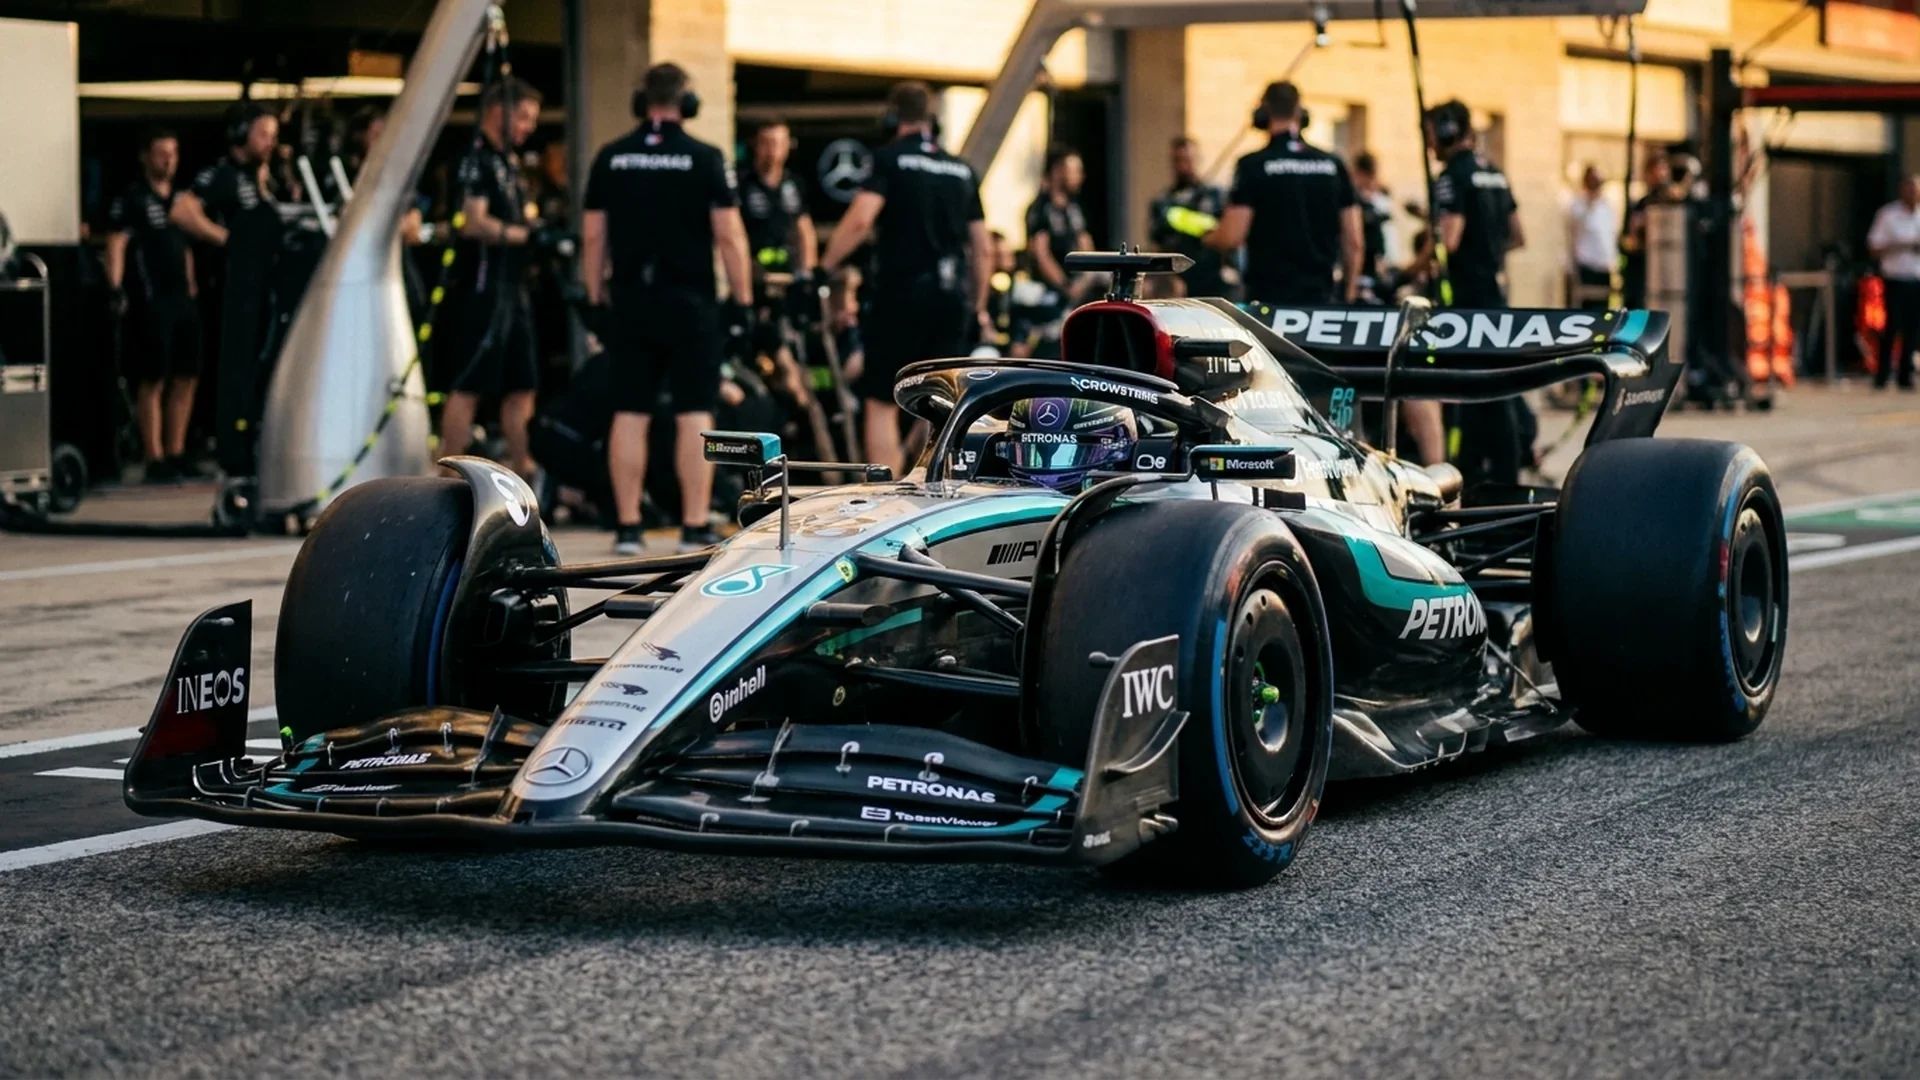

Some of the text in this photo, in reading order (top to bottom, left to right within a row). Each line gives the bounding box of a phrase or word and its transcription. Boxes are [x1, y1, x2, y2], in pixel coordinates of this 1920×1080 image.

[177, 667, 245, 714] INEOS
[1121, 664, 1174, 718] IWC
[867, 775, 996, 804] PETRONAS
